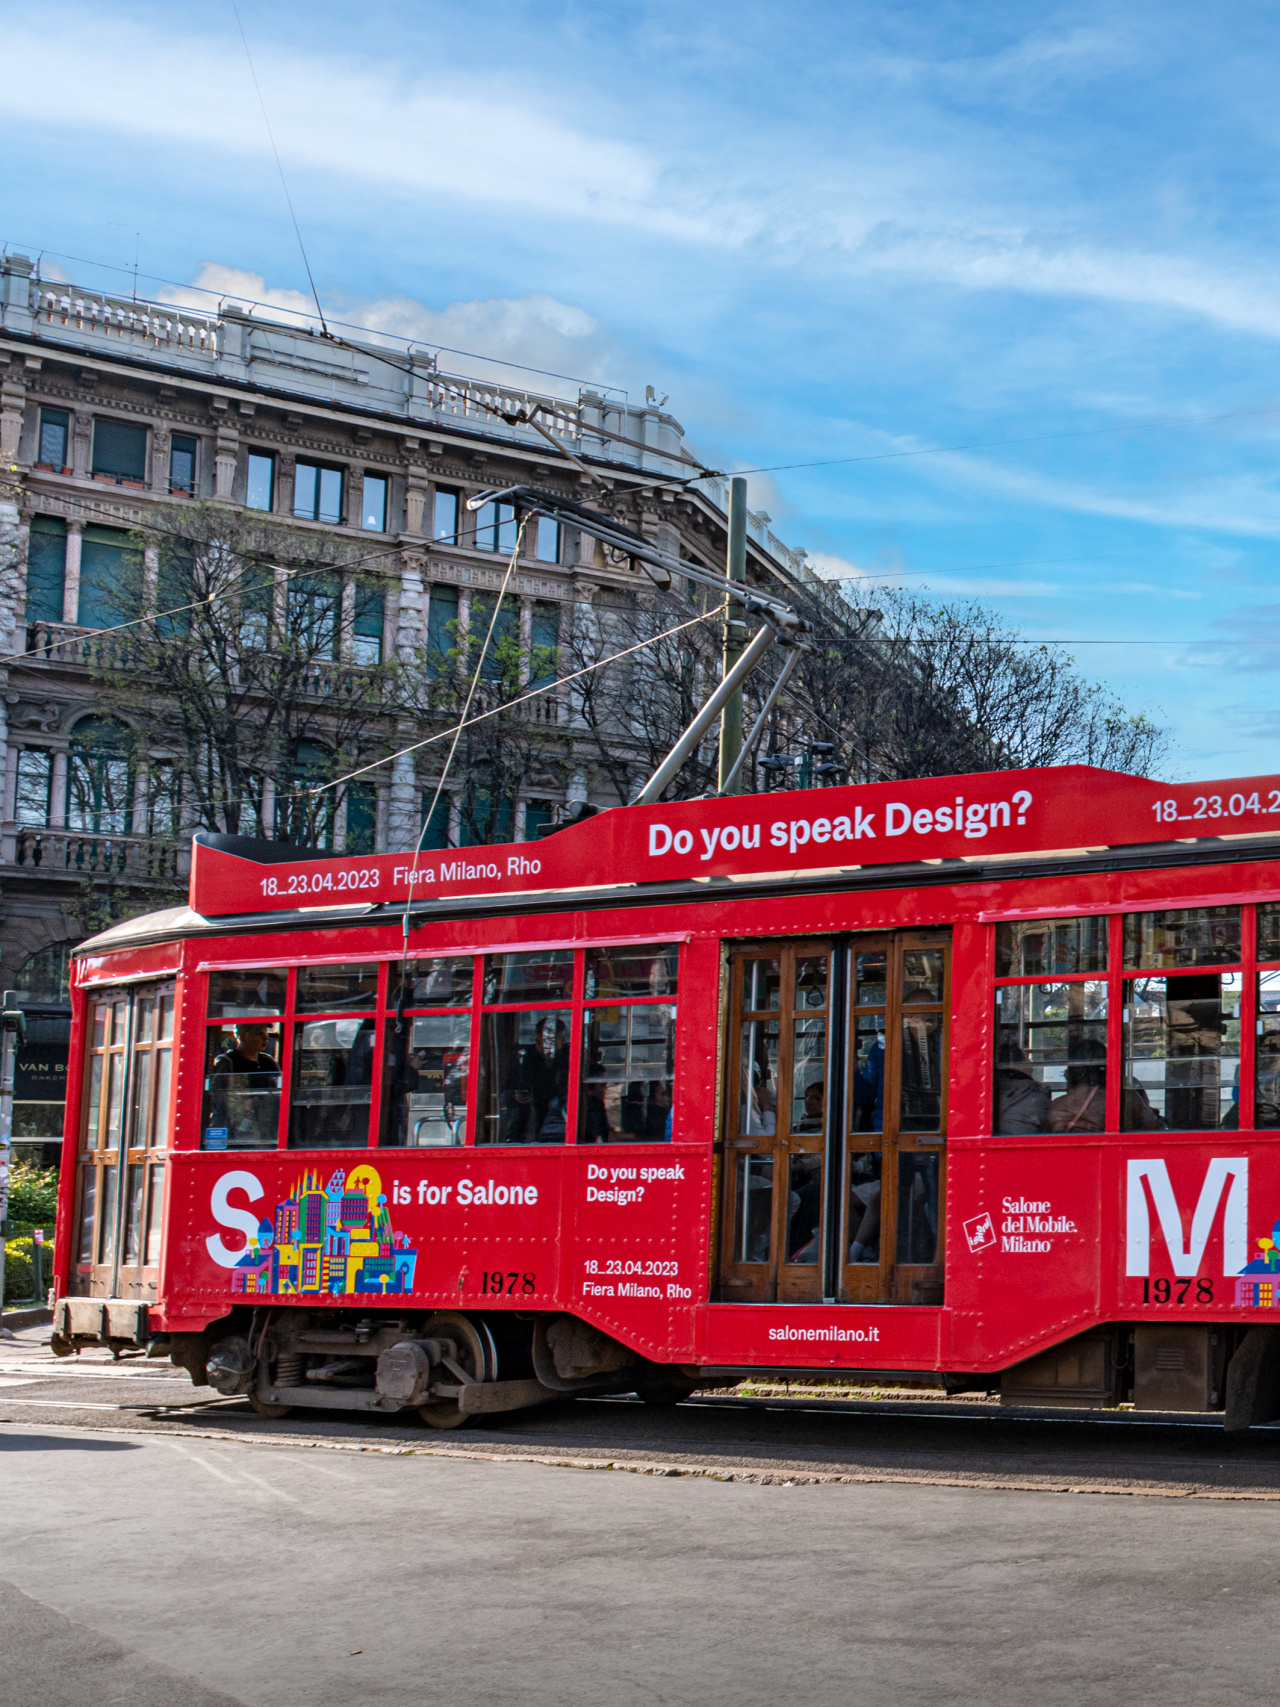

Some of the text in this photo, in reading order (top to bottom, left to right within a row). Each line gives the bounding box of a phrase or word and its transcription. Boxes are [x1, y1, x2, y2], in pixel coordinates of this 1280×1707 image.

[648, 790, 1033, 860] Do you speak Design?
[260, 857, 541, 896] 18_23.04.2023 Fiera Milano, Rho
[19, 1063, 49, 1071] VAN
[587, 1164, 685, 1183] Do you speak
[586, 1186, 645, 1205] Design?
[1002, 1196, 1051, 1214] Salone
[205, 1170, 538, 1269] S is for Salone
[1001, 1215, 1078, 1233] del Mobile.
[1125, 1157, 1249, 1277] M
[1001, 1235, 1051, 1253] Milano
[584, 1260, 678, 1276] 18_23.04.2023
[481, 1272, 536, 1295] 1978
[583, 1282, 692, 1300] Fiera Milano, Rho
[1142, 1278, 1214, 1304] 1978
[769, 1325, 880, 1342] salonemilano.it
